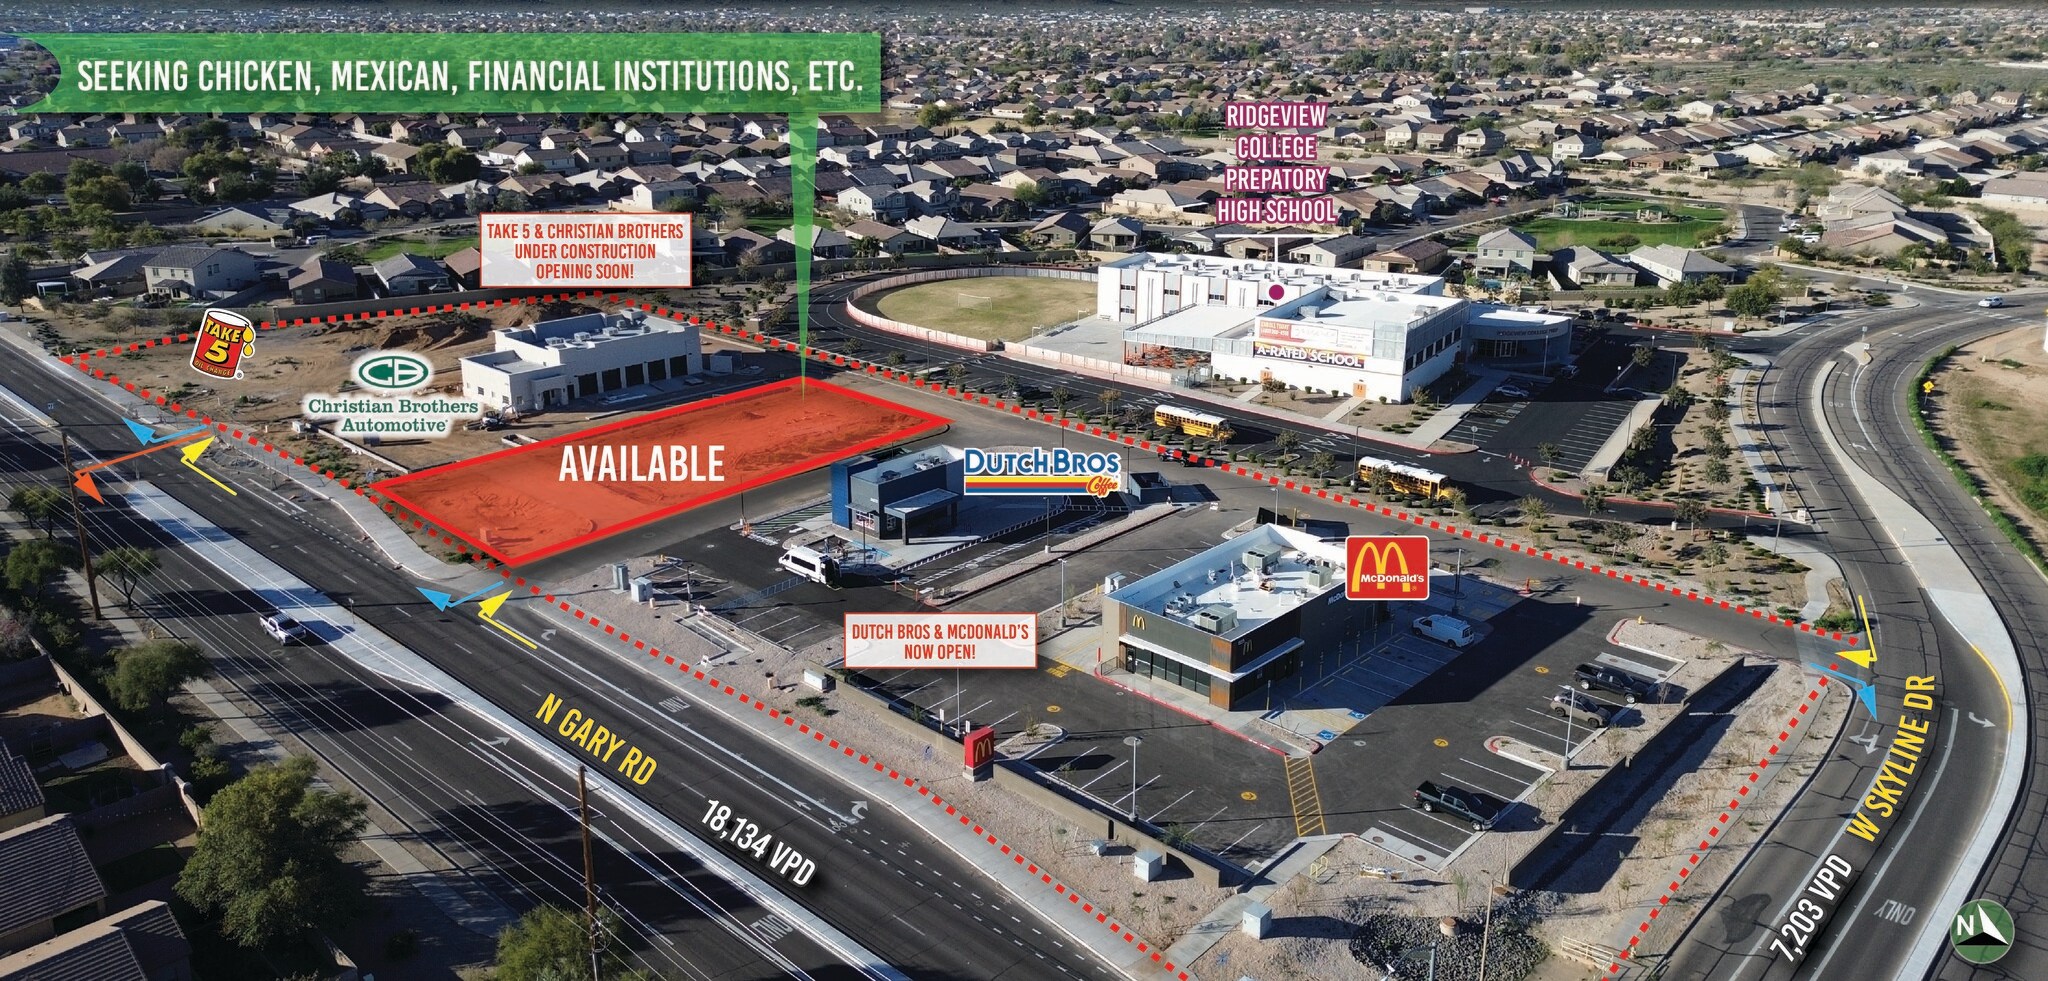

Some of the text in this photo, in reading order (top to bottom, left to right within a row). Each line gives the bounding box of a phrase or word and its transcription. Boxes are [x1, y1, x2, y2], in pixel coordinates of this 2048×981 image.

[1256, 346, 1362, 367] A-RATED SCHOOL
[658, 695, 691, 713] ONLY
[1873, 899, 1916, 926] ONLY
[749, 914, 794, 944] ONLY
